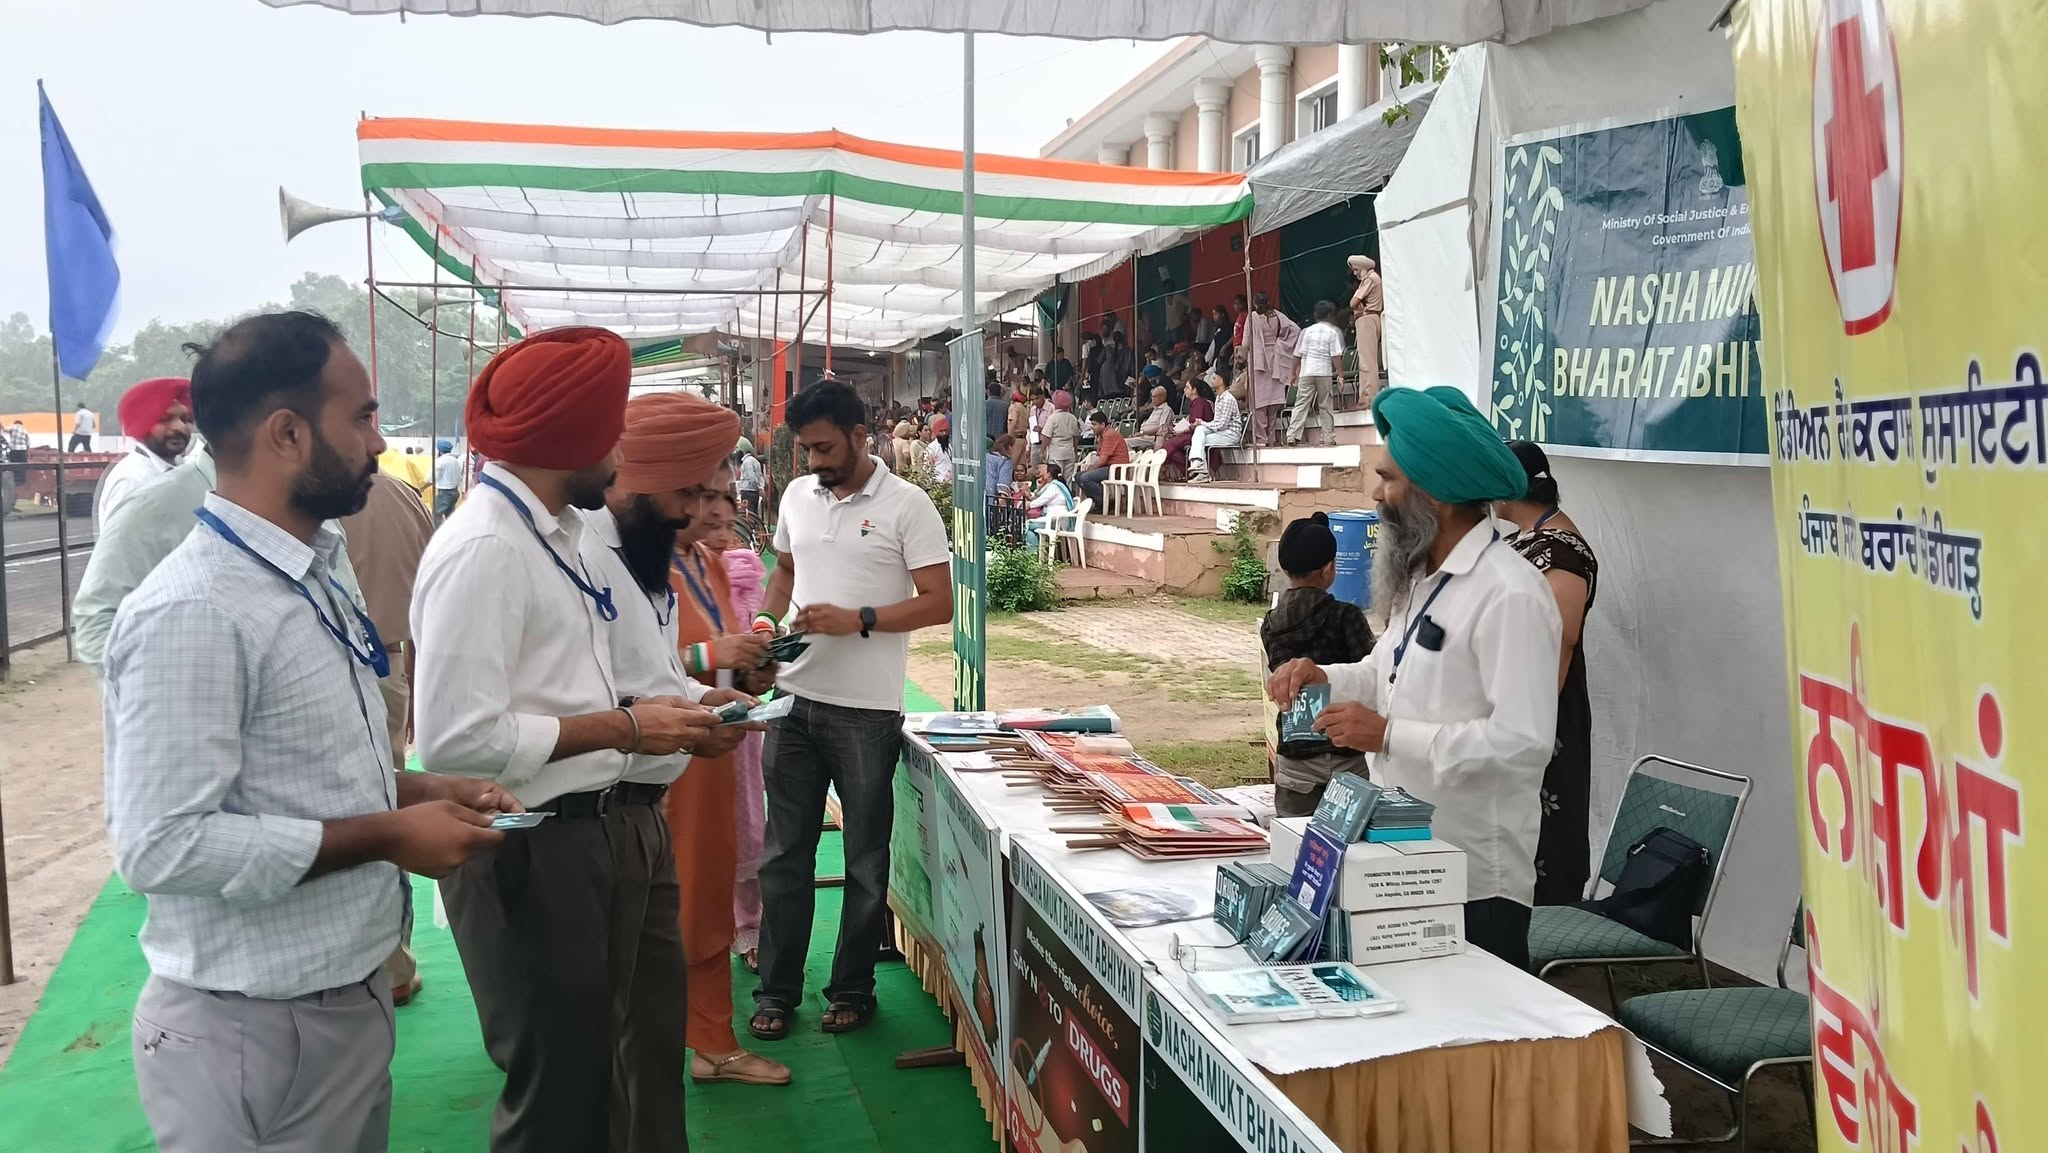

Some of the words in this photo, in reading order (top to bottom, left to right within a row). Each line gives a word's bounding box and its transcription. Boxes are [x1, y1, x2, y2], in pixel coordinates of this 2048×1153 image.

[1601, 217, 1641, 231] Ministry
[1643, 214, 1656, 226] Of
[1657, 210, 1687, 224] Social
[1689, 206, 1728, 221] Justice
[1730, 204, 1738, 216] &
[1652, 230, 1715, 246] Government
[1717, 226, 1731, 239] Of
[1732, 222, 1751, 236] Indi
[1589, 270, 1700, 326] NASHA
[1701, 261, 1761, 321] MUK
[1553, 346, 1675, 399] BHARAT
[1323, 778, 1354, 810] DRUGS
[1216, 870, 1240, 906] DRUGS
[1020, 857, 1043, 908] NASHA
[1043, 879, 1063, 930] MUKT
[1063, 901, 1095, 965] BHARAT
[1095, 935, 1136, 1010] ABHIYAN
[1026, 926, 1045, 959] Make
[1045, 949, 1058, 974] the
[1058, 966, 1079, 1000] right
[1013, 948, 1030, 981] SAY
[1047, 992, 1063, 1025] TO
[1069, 1020, 1122, 1108] DRUGS
[1164, 1011, 1205, 1092] NASHA
[1206, 1052, 1245, 1133] MUKT
[1246, 1094, 1307, 1153] BHAR
